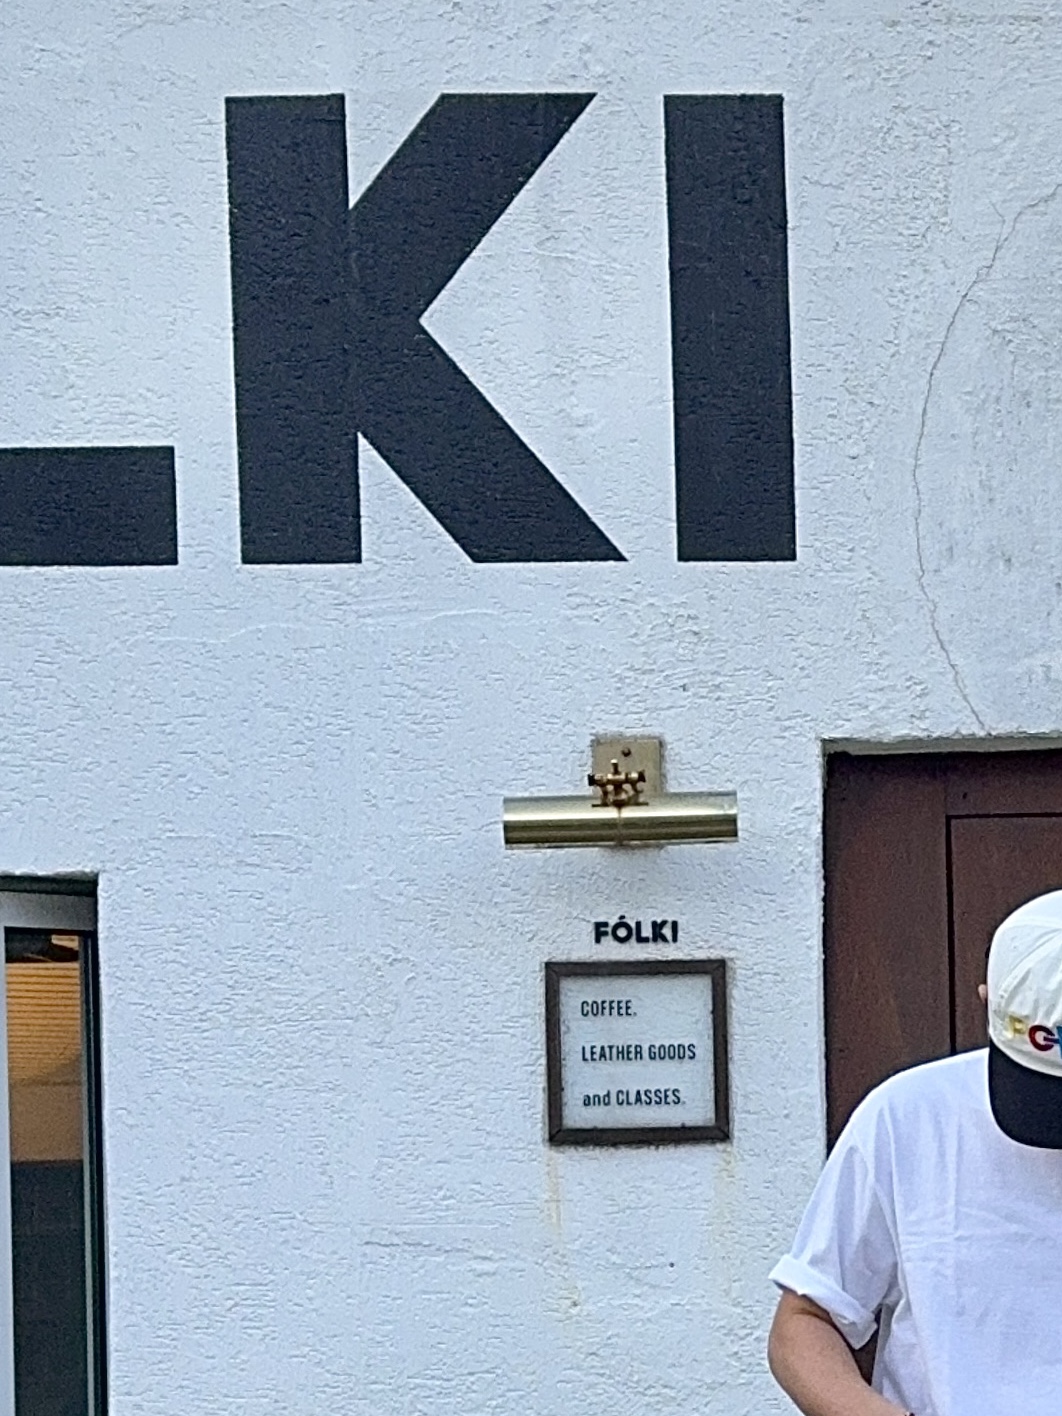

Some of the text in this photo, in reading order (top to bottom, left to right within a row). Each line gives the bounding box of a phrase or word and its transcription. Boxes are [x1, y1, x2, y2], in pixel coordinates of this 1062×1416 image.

[0, 91, 798, 567] KI
[593, 915, 679, 944] FÓLKI
[580, 999, 637, 1018] COFFEE.
[581, 1043, 697, 1062] LEATHER GOODS
[582, 1089, 611, 1107] and
